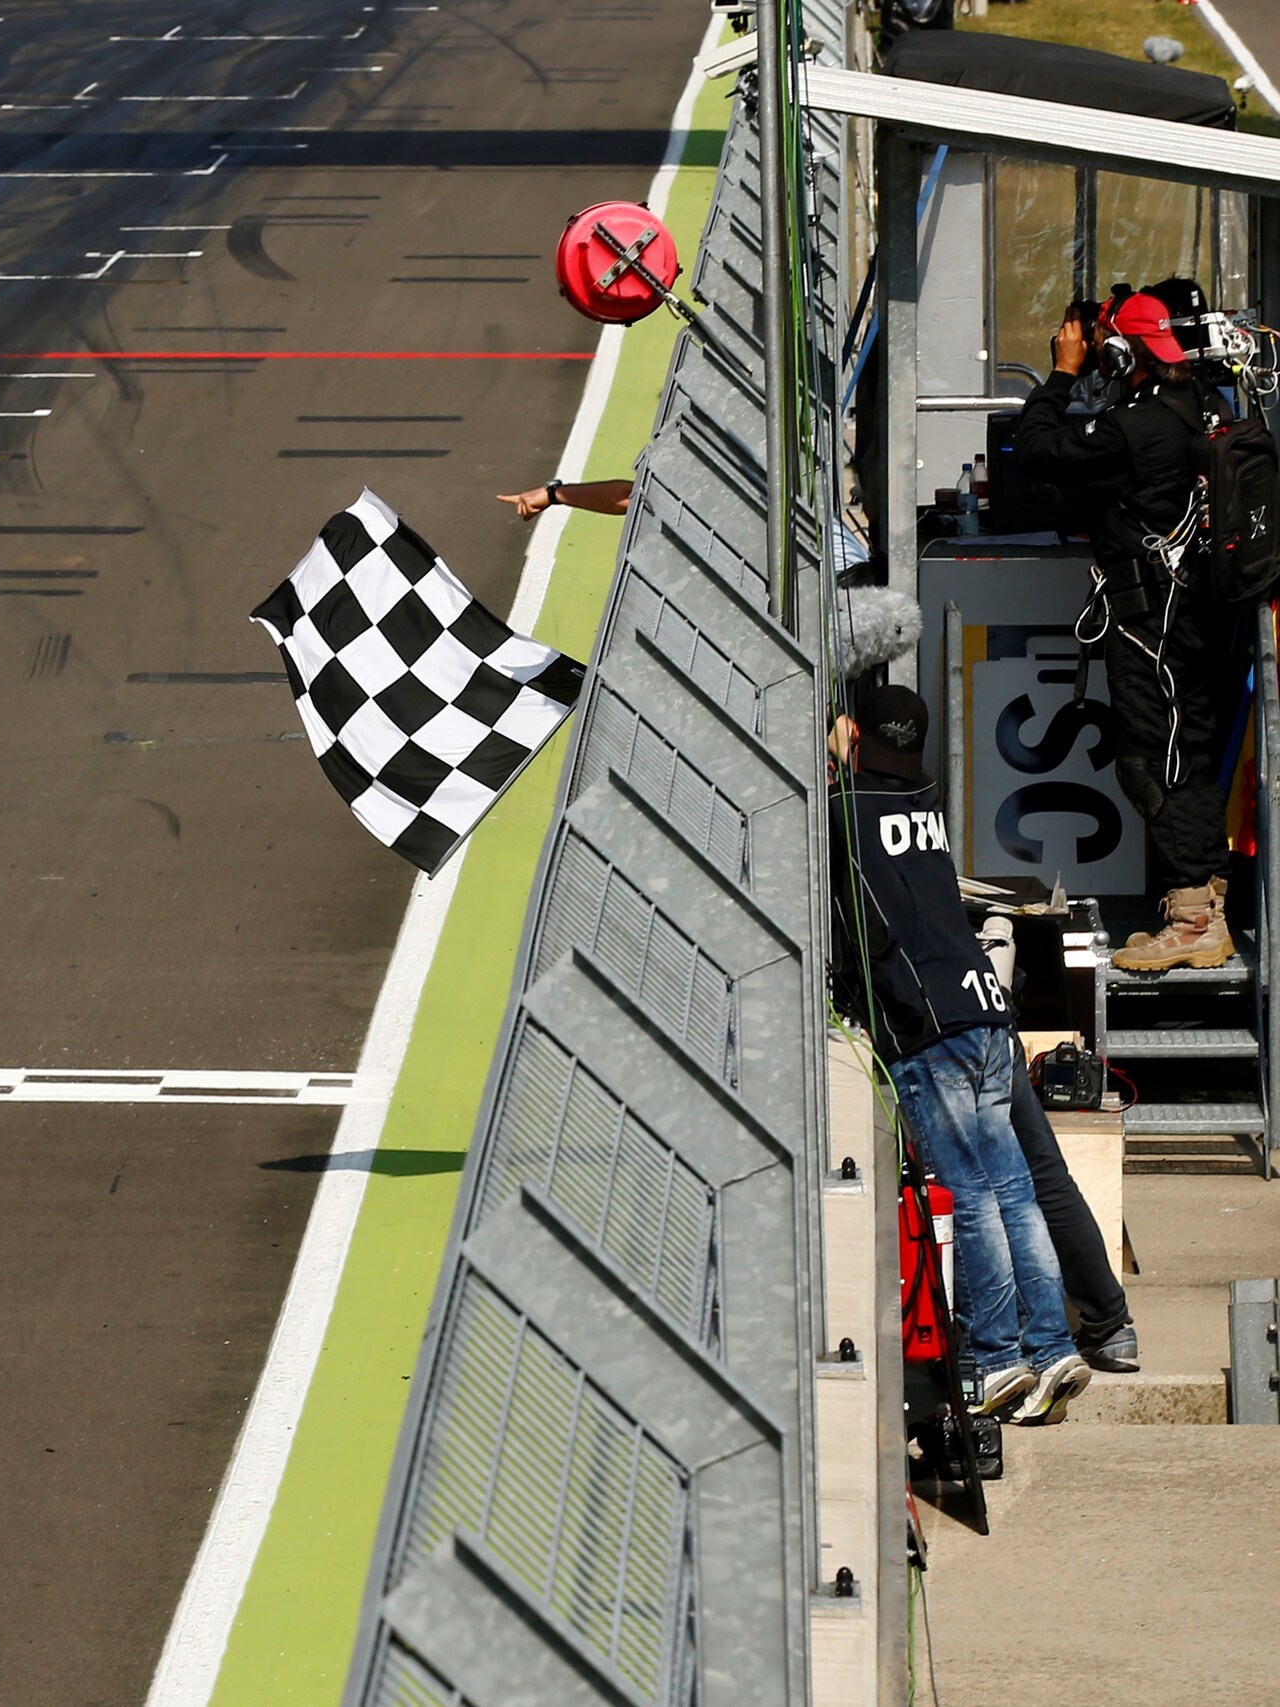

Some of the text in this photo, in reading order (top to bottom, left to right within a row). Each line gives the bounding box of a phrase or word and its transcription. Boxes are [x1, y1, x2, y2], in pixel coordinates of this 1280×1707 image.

[995, 693, 1123, 864] SC
[879, 811, 951, 856] DTM
[961, 969, 1006, 1012] 18
